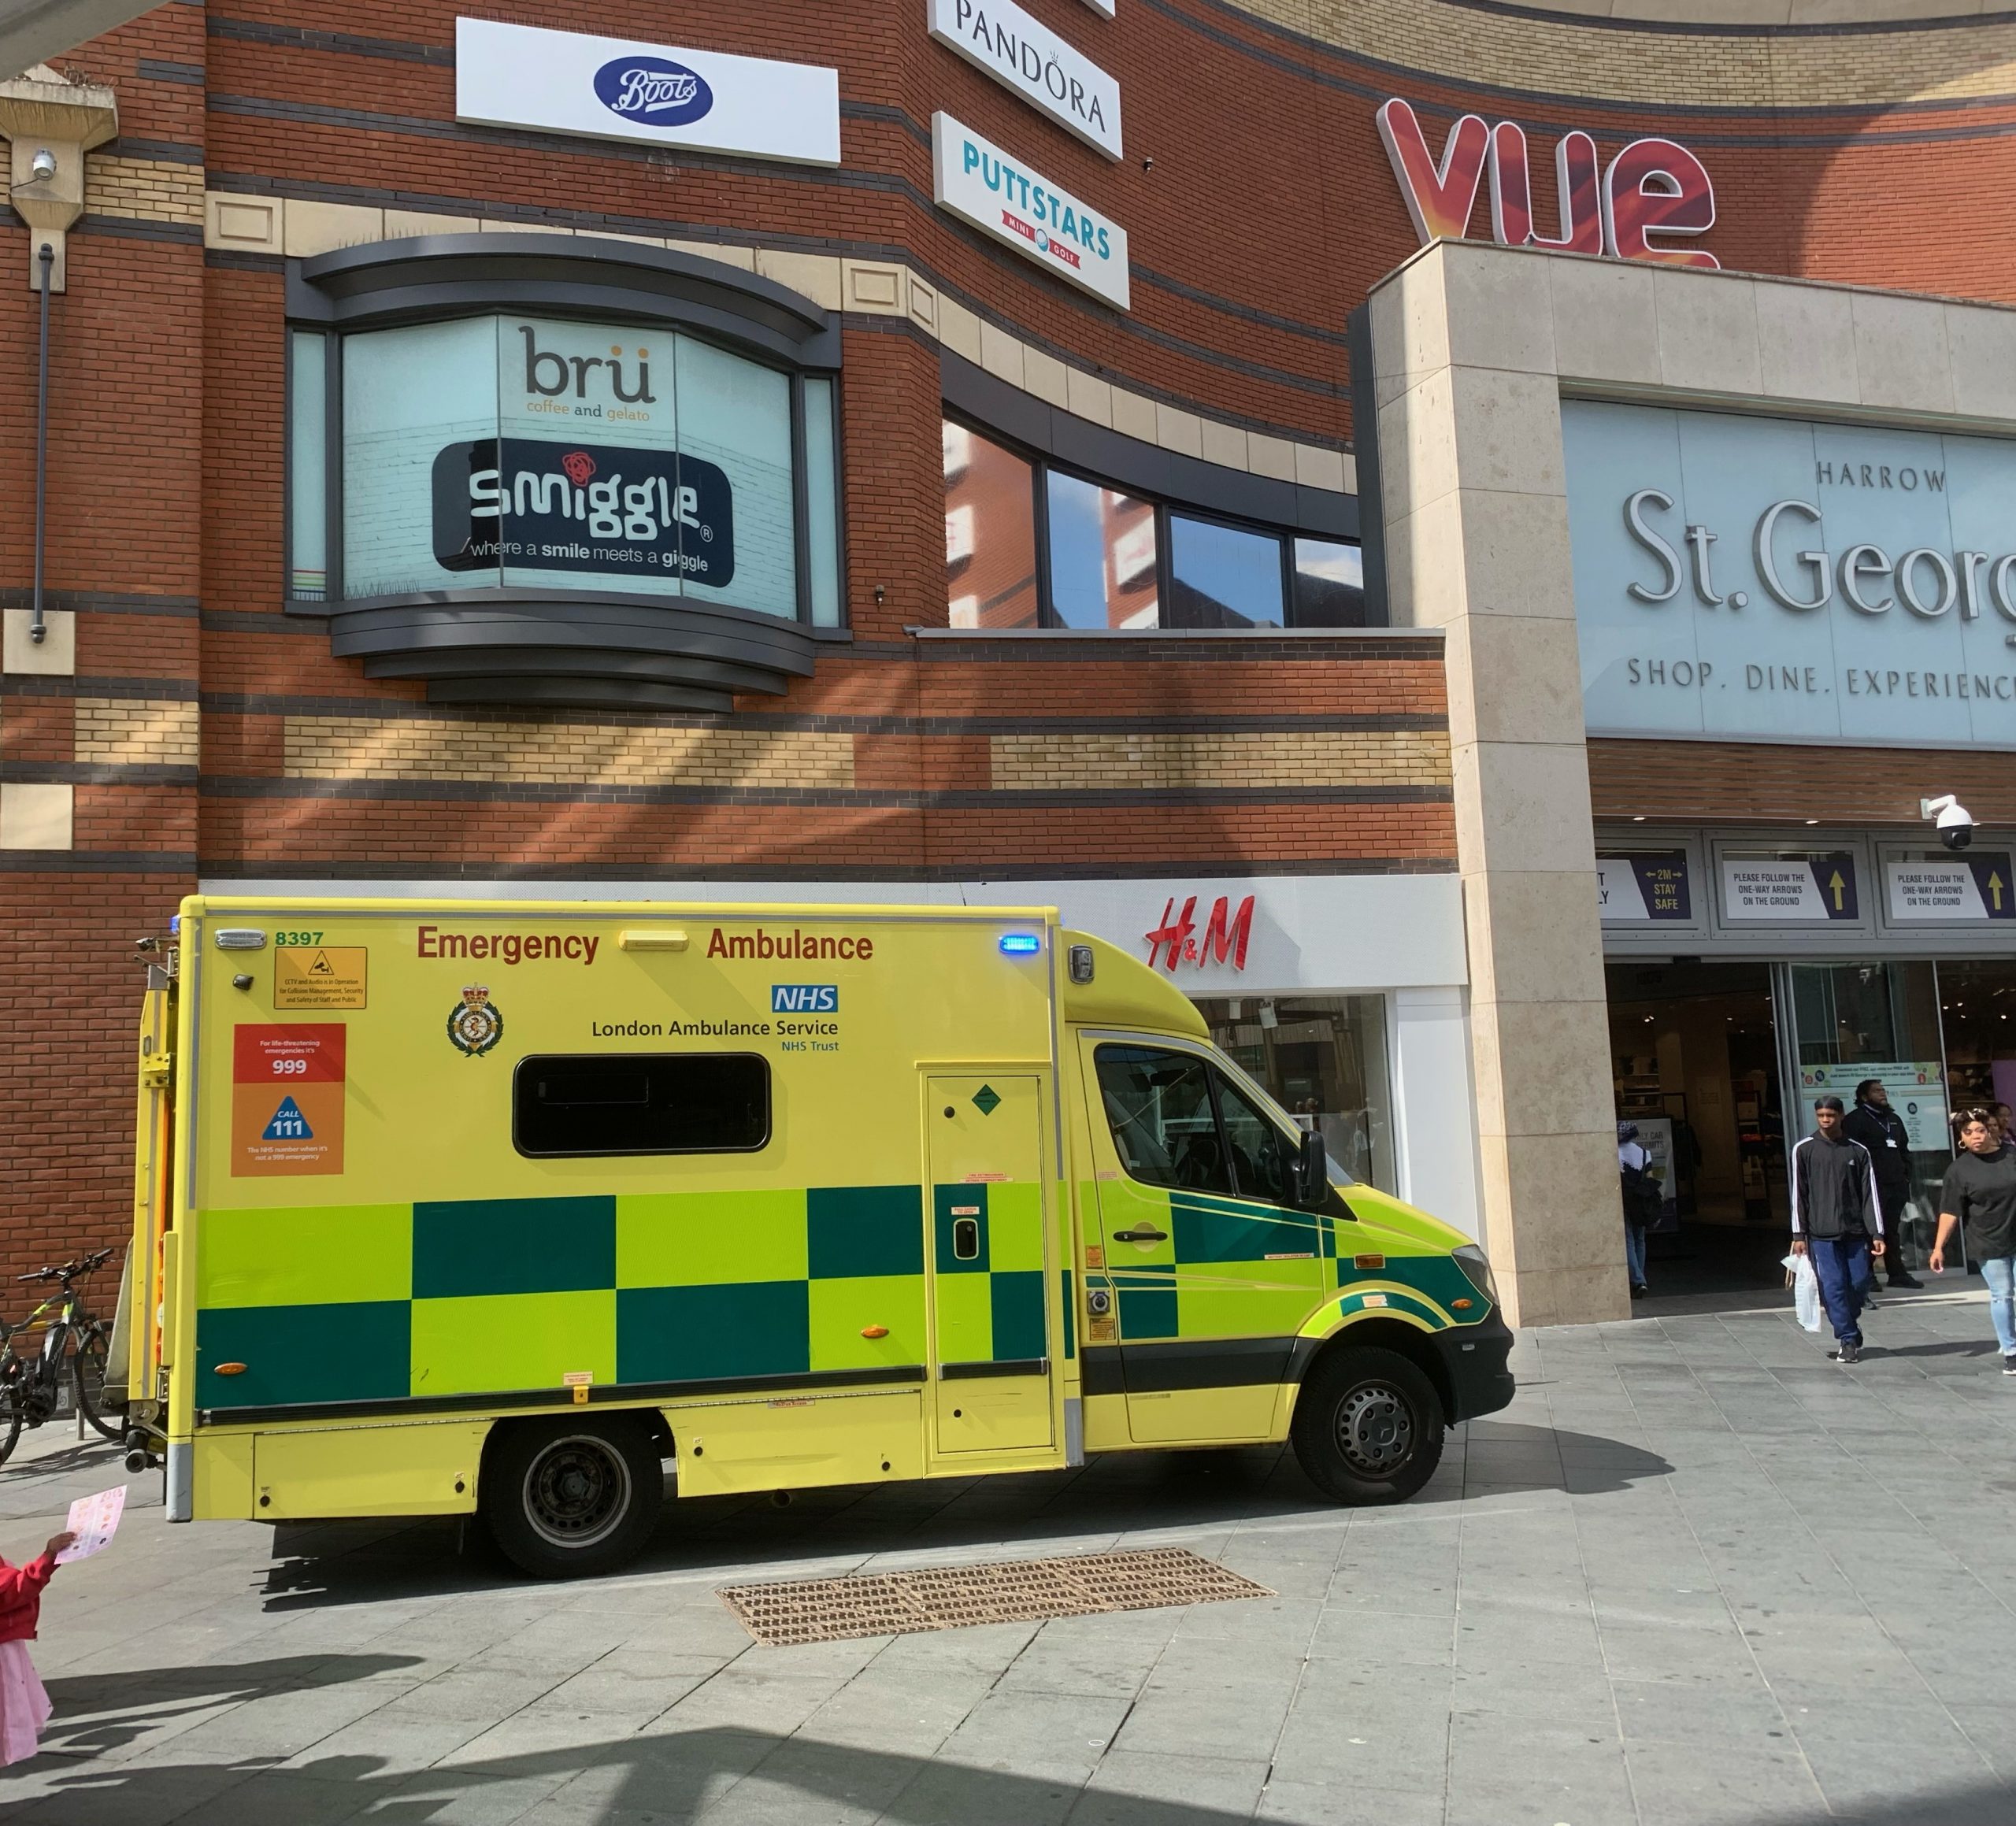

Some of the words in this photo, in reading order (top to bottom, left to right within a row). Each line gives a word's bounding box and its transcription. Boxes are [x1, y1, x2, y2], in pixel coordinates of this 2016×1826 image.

[955, 0, 1106, 134] PANDORA
[611, 69, 698, 113] Boots
[963, 139, 1111, 261] PUTTSTARS
[1008, 217, 1030, 237] MINI
[1054, 244, 1075, 264] GOLF
[518, 325, 657, 404] brü
[527, 400, 570, 415] coffee
[574, 404, 602, 417] and
[606, 406, 650, 422] gelato
[1816, 461, 1946, 493] HARROW
[469, 458, 701, 541] smiggle
[471, 540, 521, 557] where
[526, 544, 537, 556] a
[541, 542, 591, 559] smile
[593, 546, 644, 563] meets
[647, 552, 658, 564] a
[662, 549, 709, 572] giggle
[1847, 668, 2016, 701] EXPERIENC
[1657, 869, 1673, 880] 2M
[1733, 873, 1760, 882] PLEASE
[1762, 873, 1790, 882] FOLLOW
[1792, 874, 1805, 883] THE
[1897, 875, 1922, 883] PLEASE
[1924, 875, 1951, 883] FOLLOW
[1953, 875, 1966, 883] THE
[1654, 883, 1677, 895] STAY
[1738, 885, 1770, 894] ONE-WAY
[1772, 885, 1803, 894] ARROWS
[1902, 886, 1932, 894] ONE-WAY
[1934, 886, 1963, 894] ARROWS
[1655, 898, 1679, 909] SAFE
[1743, 897, 1754, 906] ON
[1755, 897, 1769, 906] THE
[1770, 897, 1799, 906] GROUND
[1907, 897, 1917, 906] ON
[275, 932, 324, 946] 8397
[1144, 894, 1256, 972] H&M
[417, 925, 599, 965] Emergency
[706, 928, 874, 961] Ambulance
[344, 987, 364, 996] Security
[773, 987, 836, 1011] NHS
[591, 1020, 662, 1037] London
[669, 1020, 770, 1036] Ambulance
[776, 1020, 839, 1035] Service
[271, 1039, 321, 1048] life-threatening
[782, 1041, 806, 1051] NHS
[810, 1041, 839, 1051] Trust
[272, 1059, 307, 1075] 999
[272, 1120, 302, 1136] 111
[285, 1154, 320, 1162] emergency
